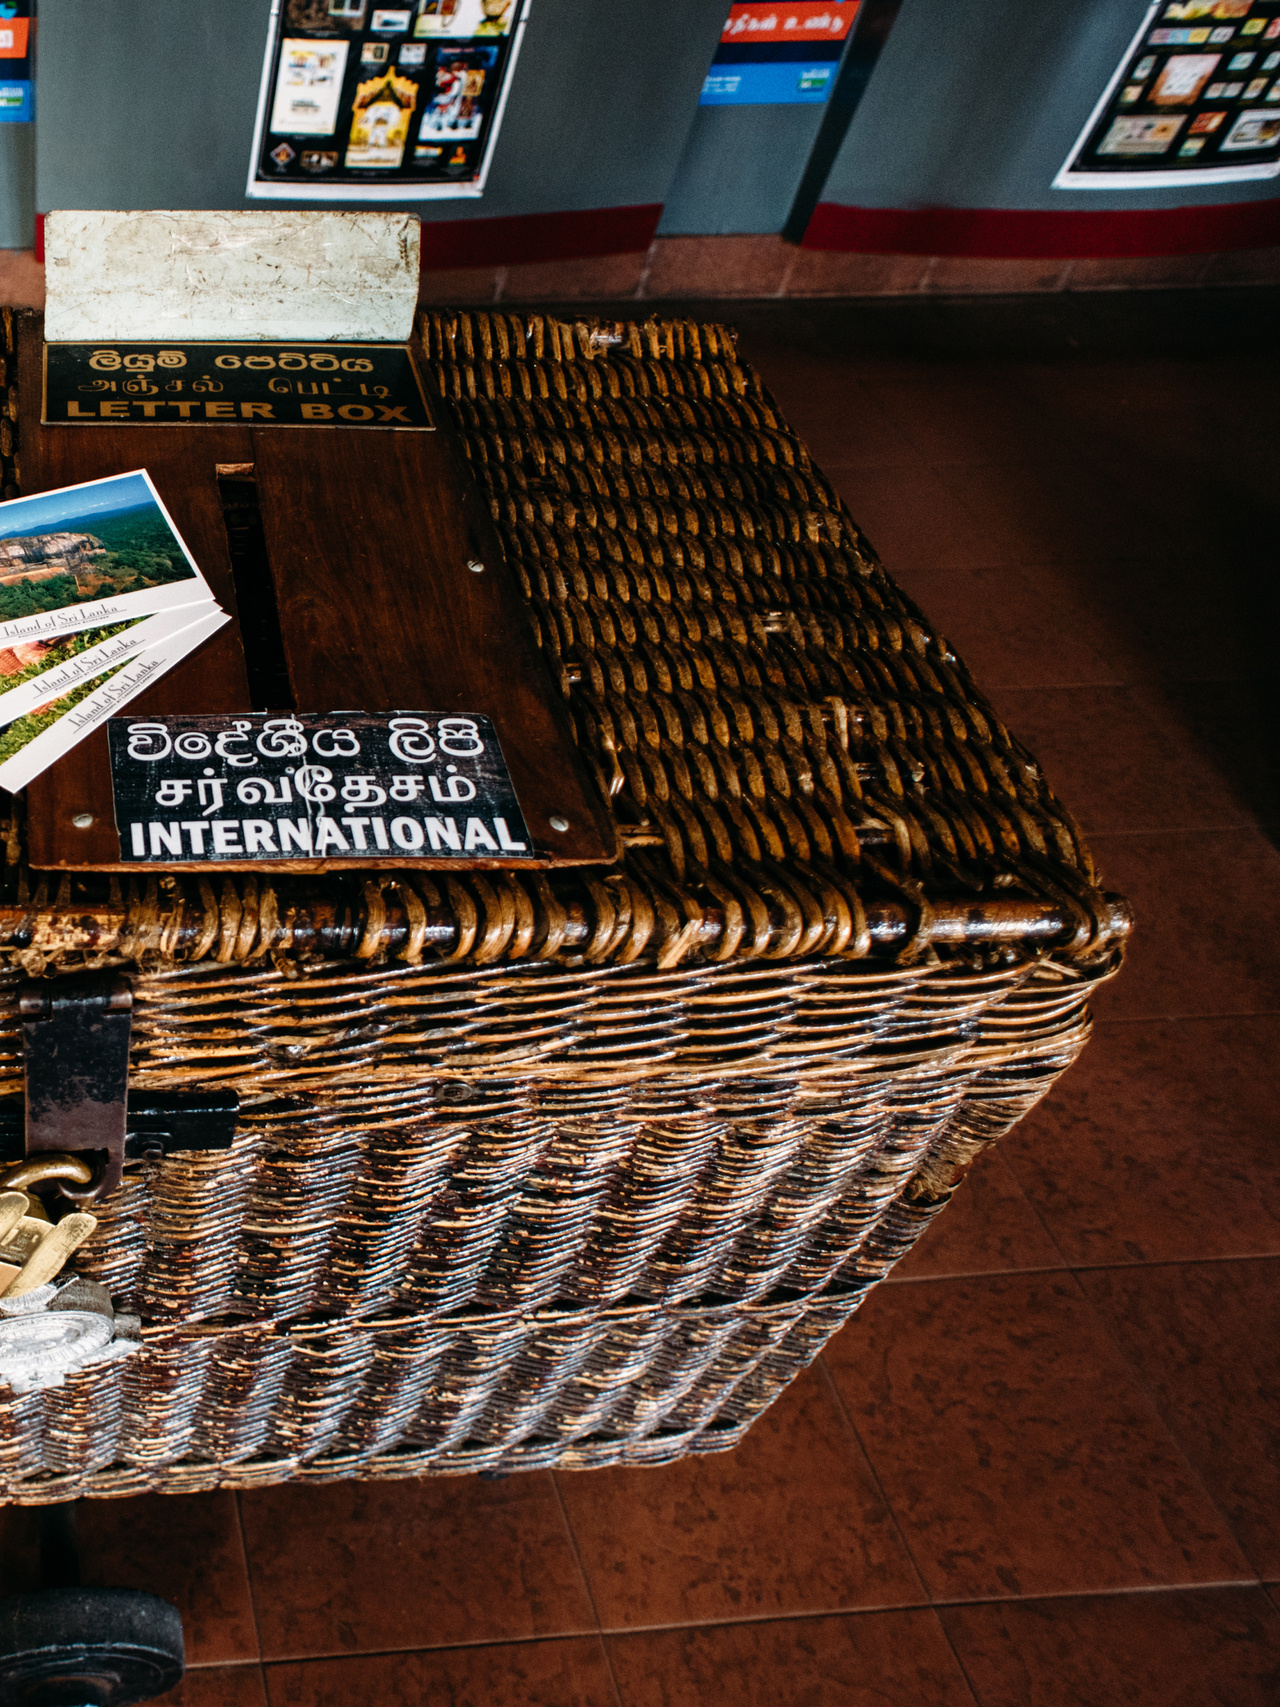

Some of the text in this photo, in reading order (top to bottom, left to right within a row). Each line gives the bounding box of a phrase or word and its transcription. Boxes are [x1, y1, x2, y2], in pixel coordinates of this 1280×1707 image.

[214, 352, 374, 373] පෙට්ටිය
[78, 374, 393, 399] அஞ்சல் பெட்டி
[67, 400, 414, 422] LETTER BOX
[4, 604, 118, 637] Island of Sri Lanka
[33, 639, 136, 693] Island of Sri Lanka
[68, 660, 159, 727] Island of Sri Lanka
[127, 717, 485, 767] විදේශීය ලිපි
[130, 816, 528, 857] INTERNATIONAL
